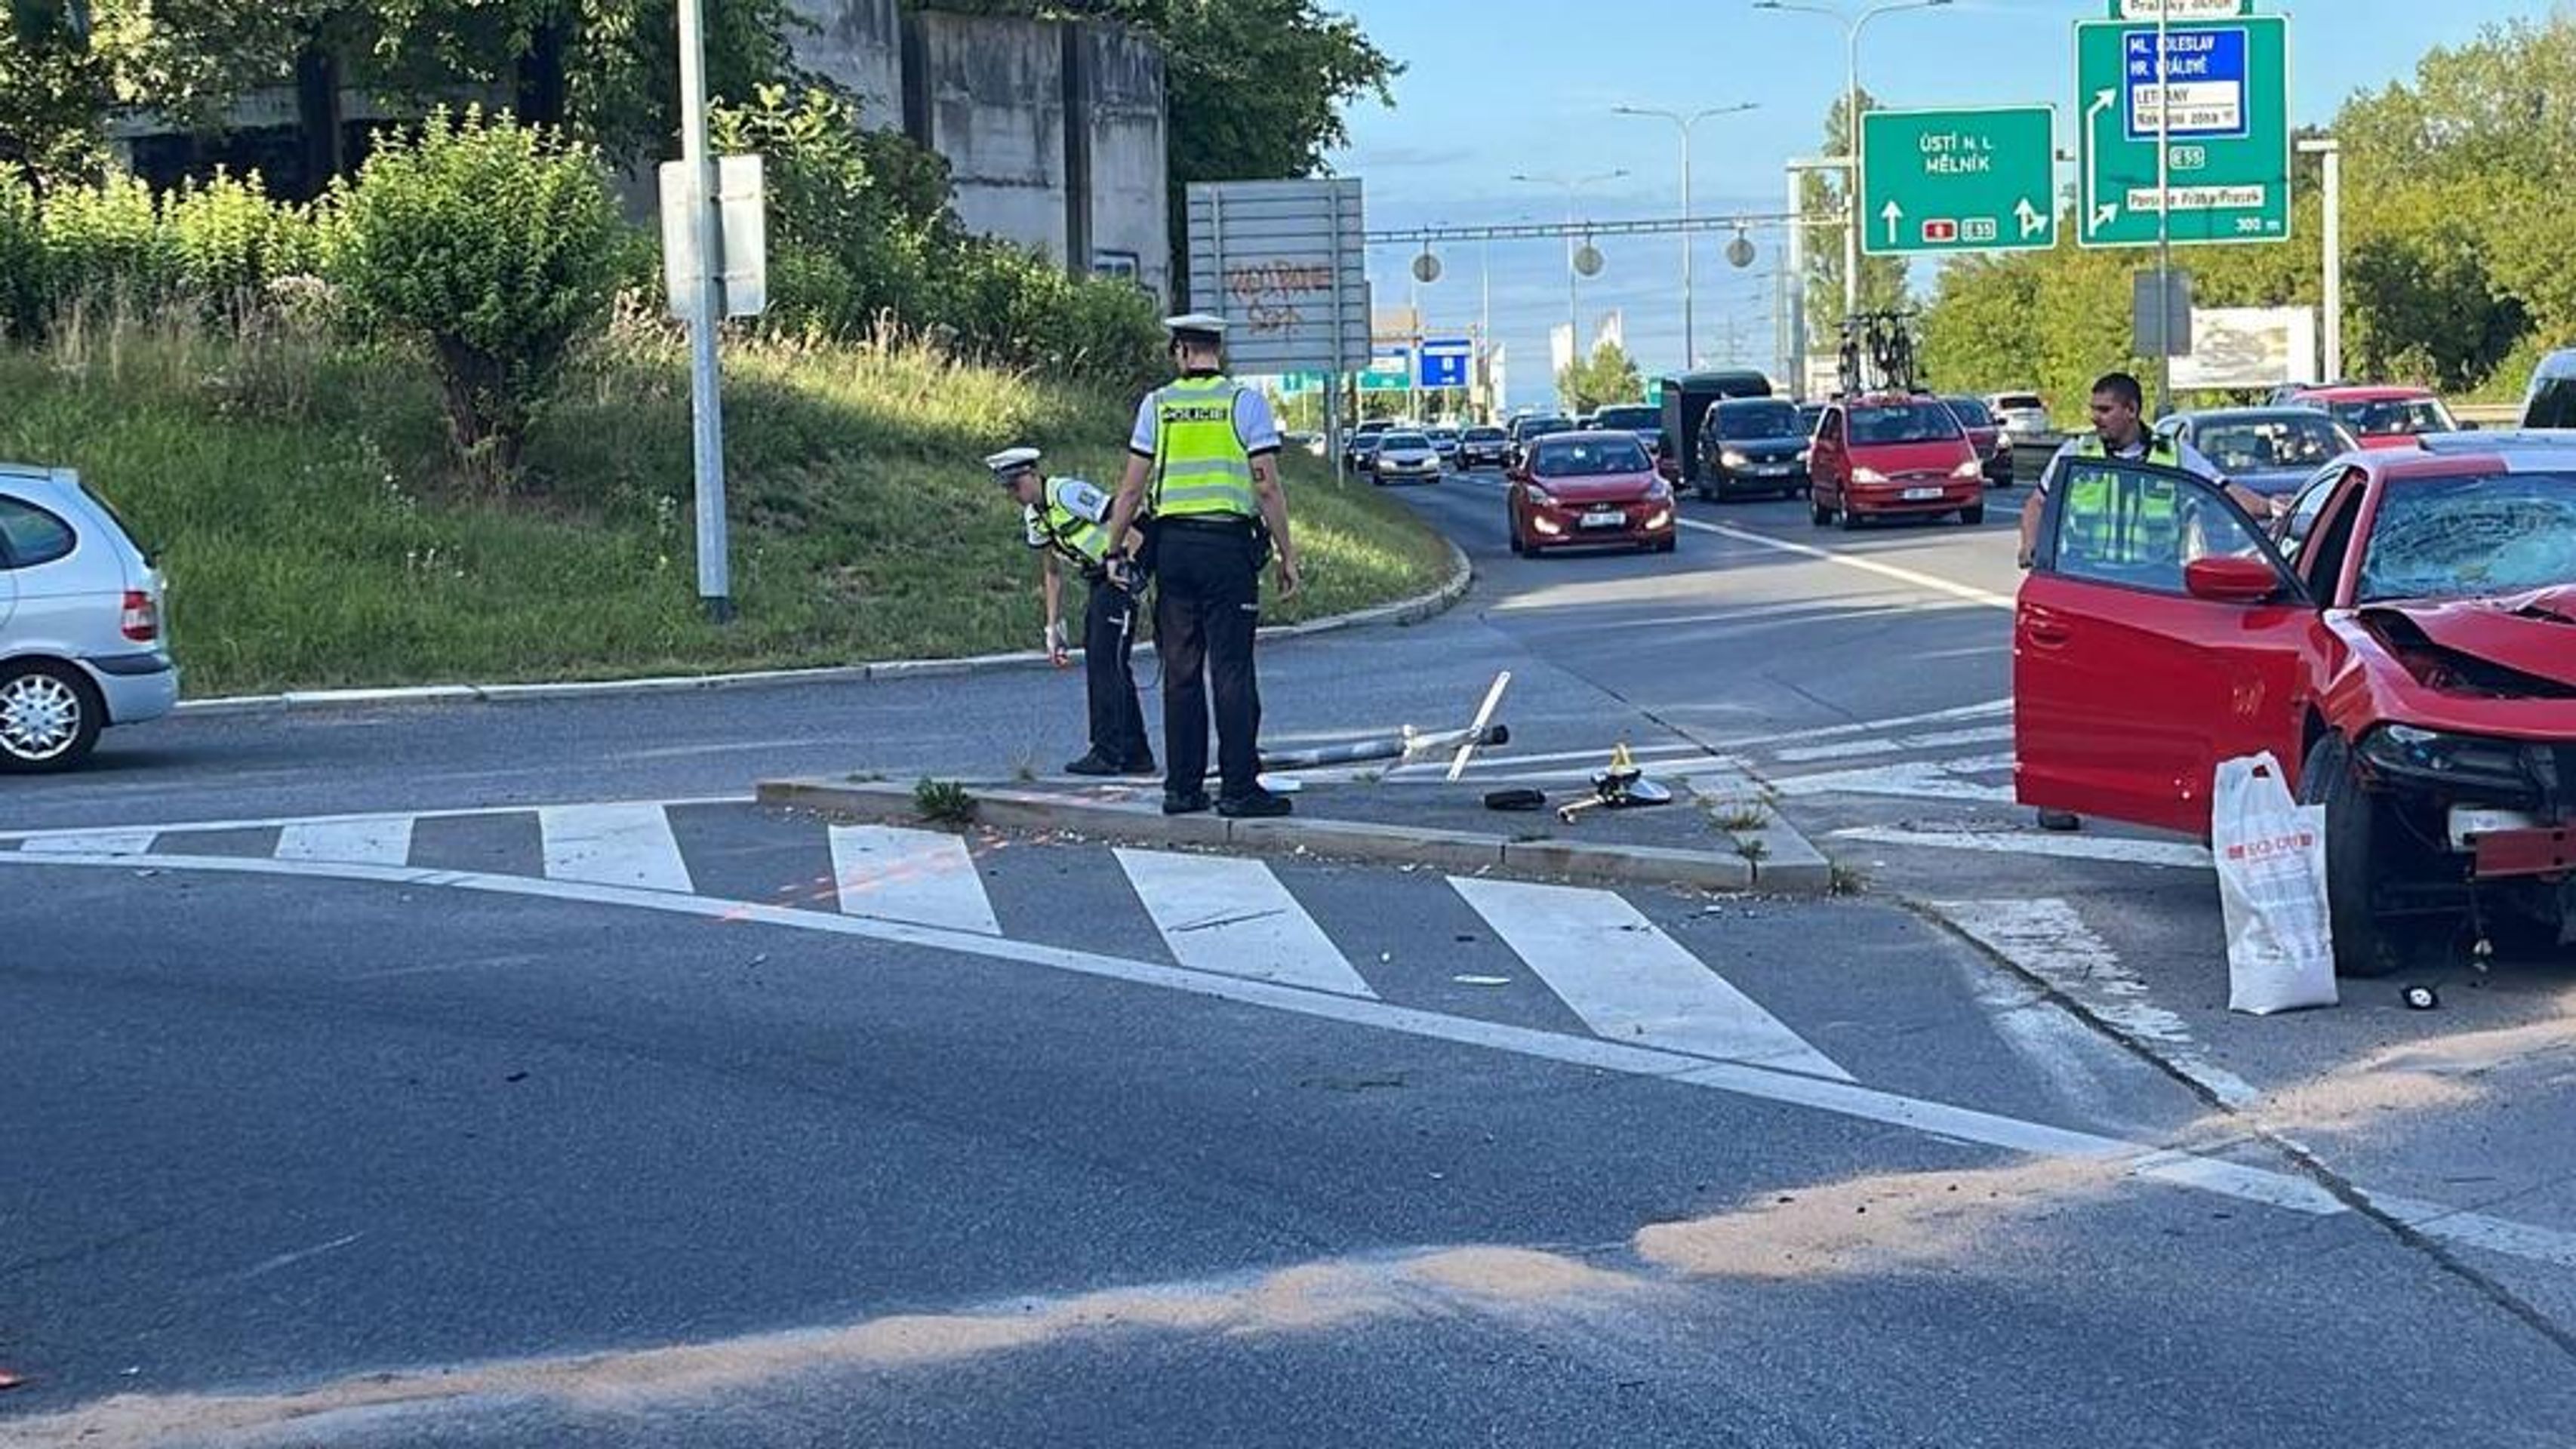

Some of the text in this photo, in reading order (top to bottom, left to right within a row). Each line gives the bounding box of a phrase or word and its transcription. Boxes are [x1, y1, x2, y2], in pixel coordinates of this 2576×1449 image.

[2136, 88, 2189, 104] LETANY
[1919, 131, 1956, 152] ÚSTÍ
[1925, 153, 1990, 173] MĚLNÍK
[2235, 217, 2261, 232] 300
